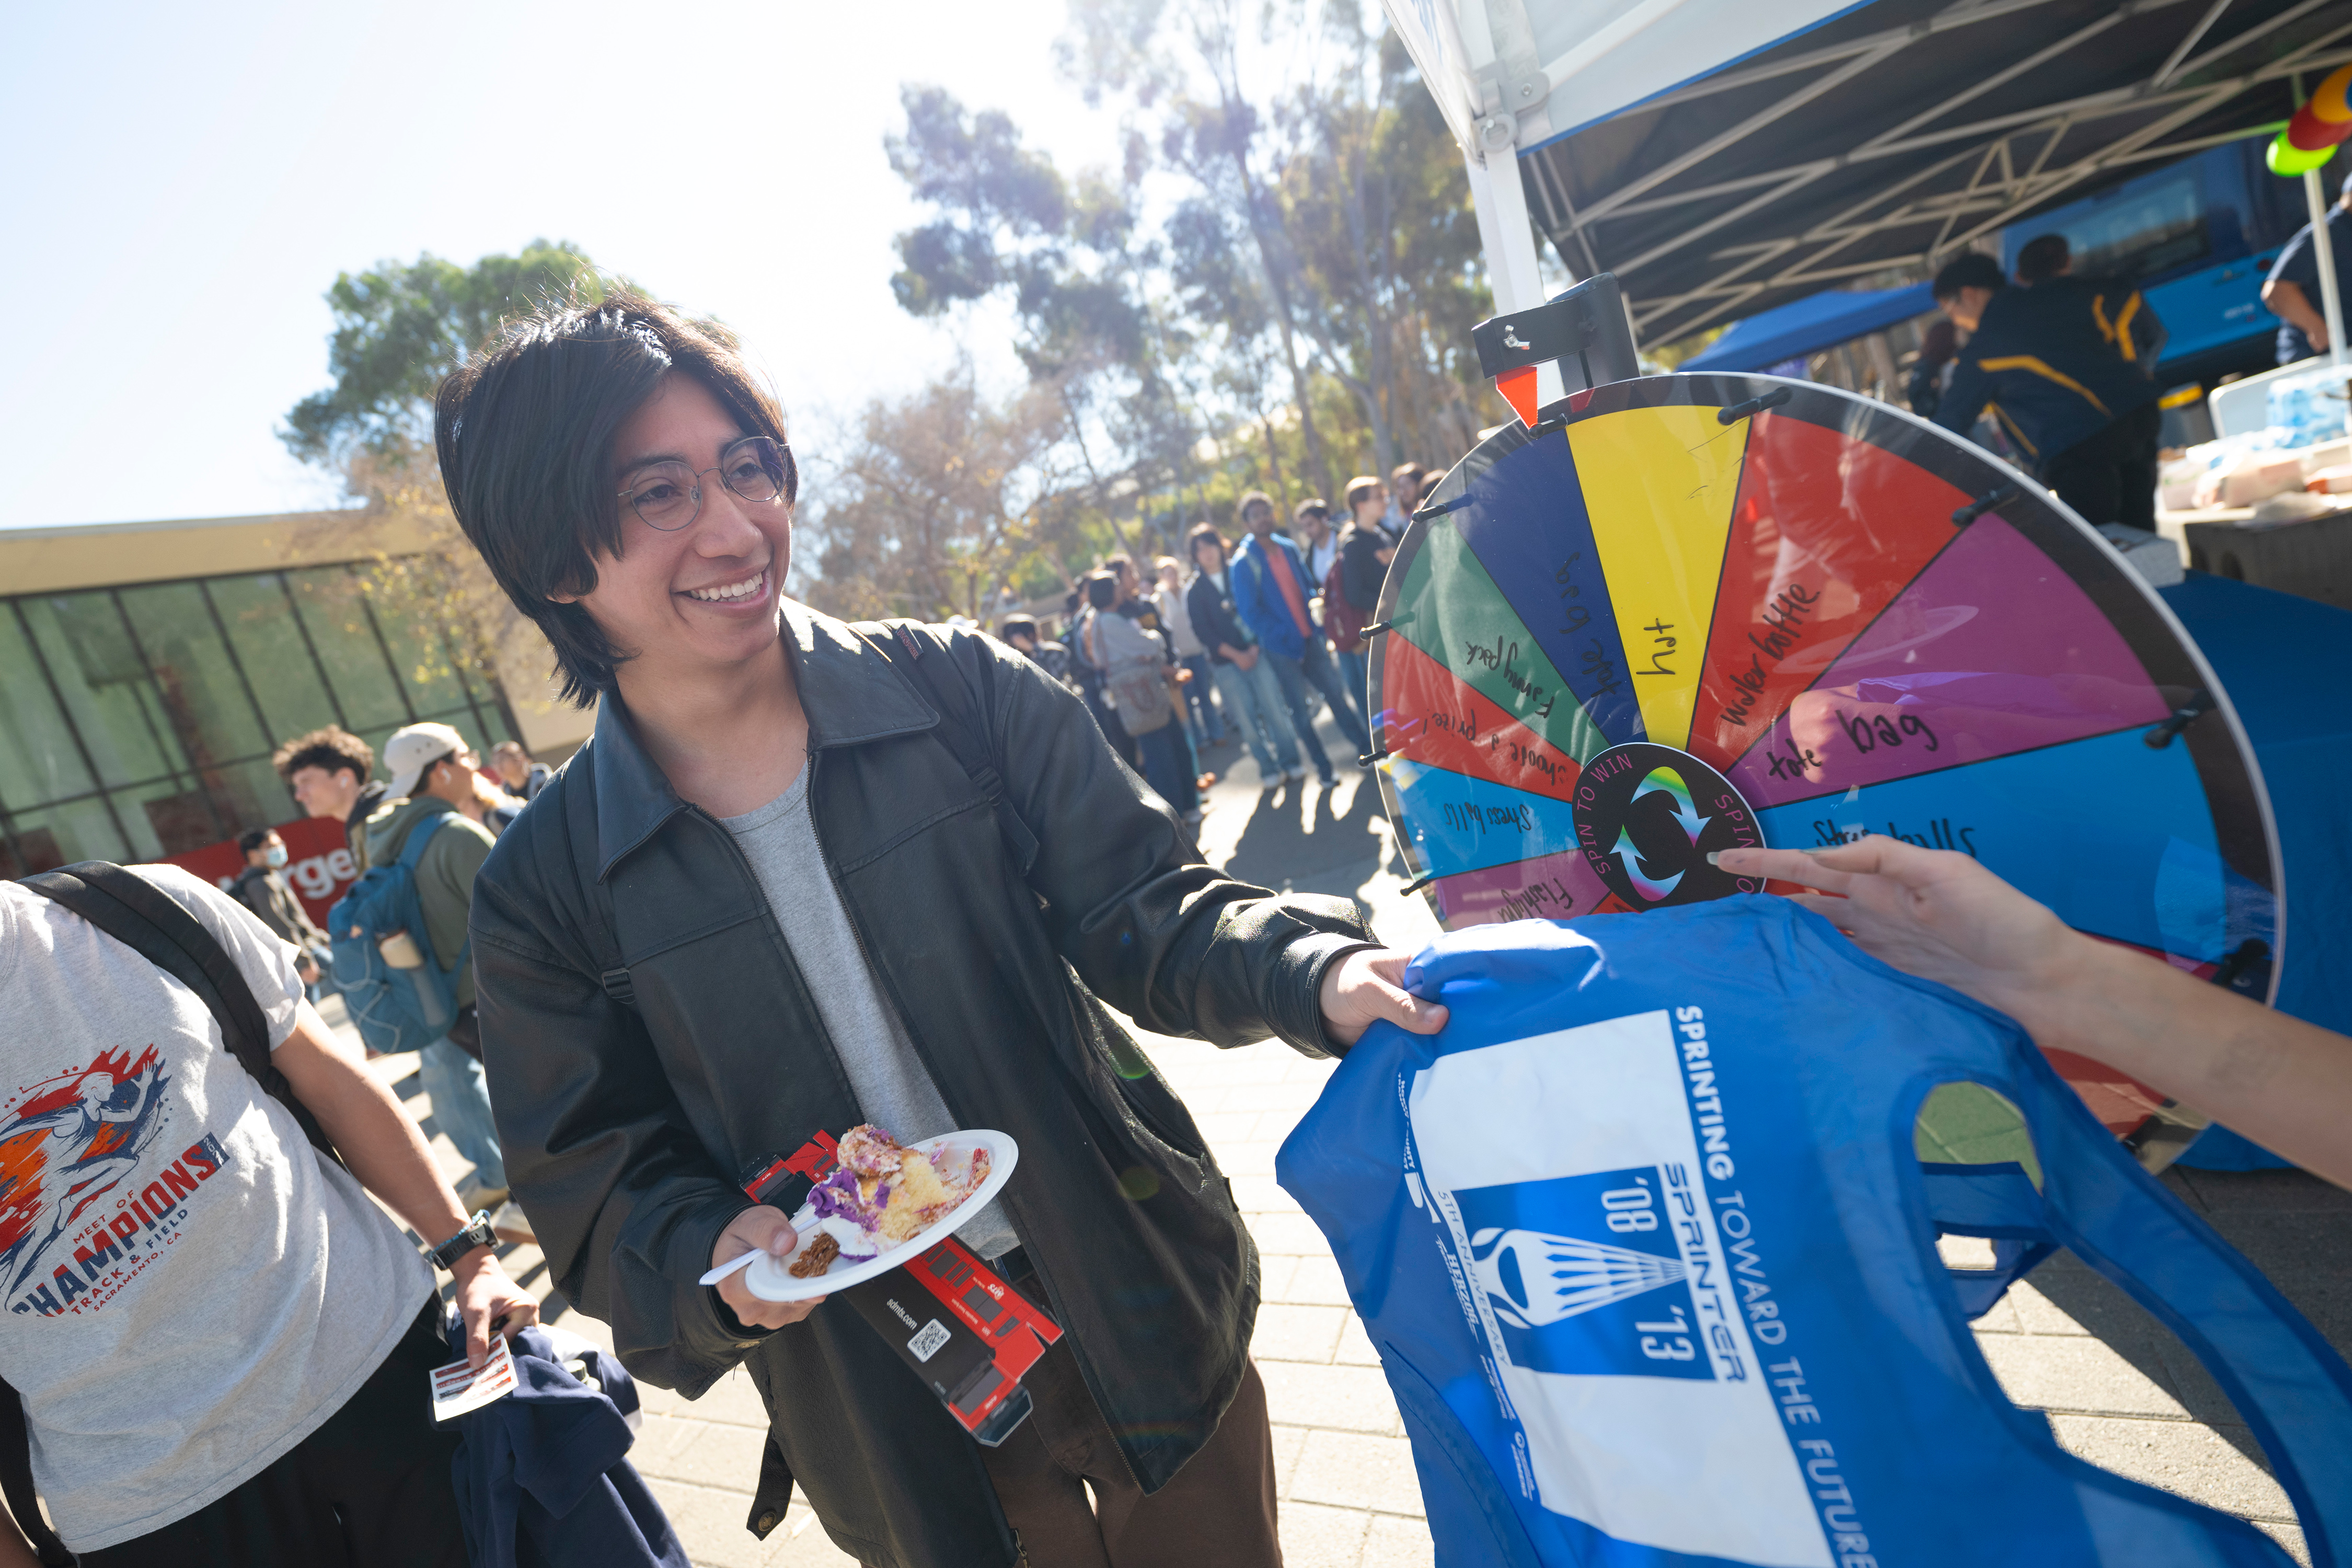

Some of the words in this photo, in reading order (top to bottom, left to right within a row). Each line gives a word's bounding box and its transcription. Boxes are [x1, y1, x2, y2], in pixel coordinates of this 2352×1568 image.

[1555, 551, 1591, 634] bag
[1636, 618, 1675, 675] hat
[1748, 583, 1820, 661] bottle
[1503, 641, 1554, 718] Fanny
[1581, 640, 1621, 698] tote
[1422, 709, 1476, 742] prize!
[1491, 733, 1498, 751] a
[1767, 739, 1822, 781] tote
[1835, 709, 1940, 754] bag
[1590, 753, 1633, 782] WIN
[1443, 801, 1483, 834] balls
[1485, 803, 1531, 833] Stress
[1577, 786, 1596, 813] TO
[1579, 824, 1611, 875] SPIN
[1736, 877, 1758, 893] O
[73, 1214, 107, 1244] MEET
[116, 1190, 135, 1209] OF
[71, 1266, 124, 1316] TRACK
[130, 1254, 142, 1265] &
[146, 1207, 189, 1250] FIELD
[93, 1251, 165, 1312] SACRAMENTO,
[166, 1230, 183, 1246] CA
[1438, 1190, 1461, 1224] 5TH
[1456, 1230, 1511, 1366] ANNIVERSARY
[1446, 1253, 1480, 1325] HERZOG
[1663, 1161, 1748, 1384] SPRINTER
[1676, 1005, 1735, 1181] SPRINTING
[1715, 1190, 1787, 1346] TOWARD
[1773, 1356, 1821, 1426] THE
[1797, 1439, 1880, 1568] FUTURE
[886, 1298, 918, 1331] sdmts.com
